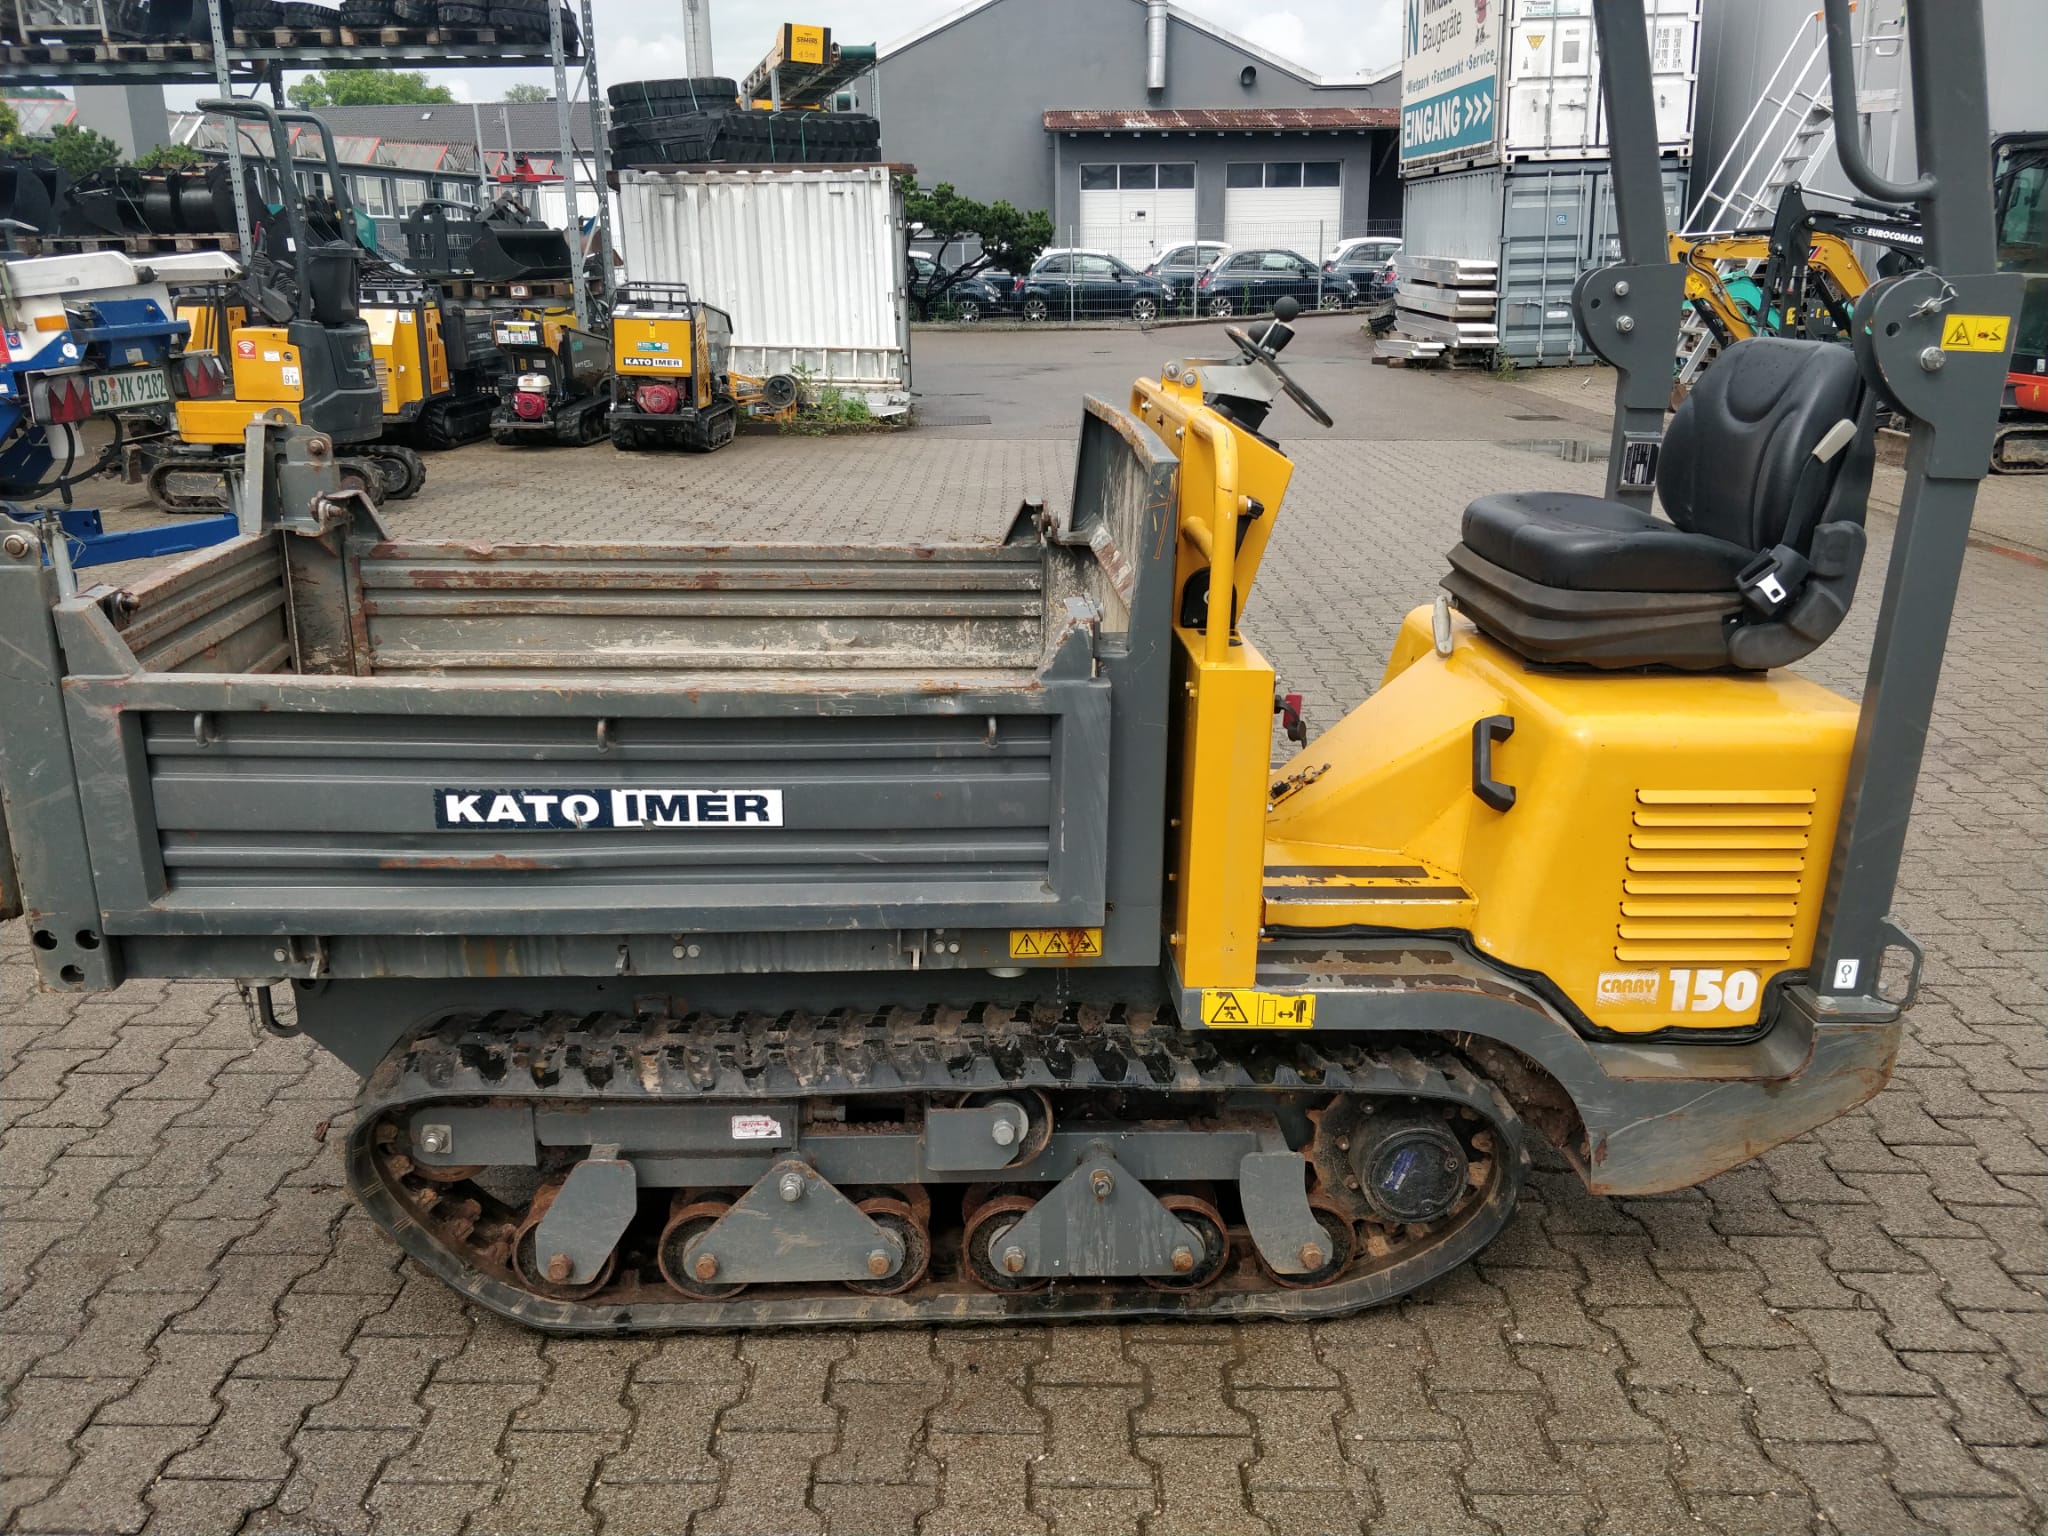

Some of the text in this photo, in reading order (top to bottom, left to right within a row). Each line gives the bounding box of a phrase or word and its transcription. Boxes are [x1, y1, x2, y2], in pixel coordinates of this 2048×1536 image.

[1423, 8, 1462, 53] Baugeräte
[1433, 58, 1464, 84] Fachmarkt
[1469, 48, 1495, 70] Service
[1404, 95, 1460, 148] EINGANG
[625, 358, 652, 366] KATO
[91, 373, 167, 406] LB XK 9182
[446, 794, 769, 823] KATO IMER
[1669, 968, 1759, 1013] 150
